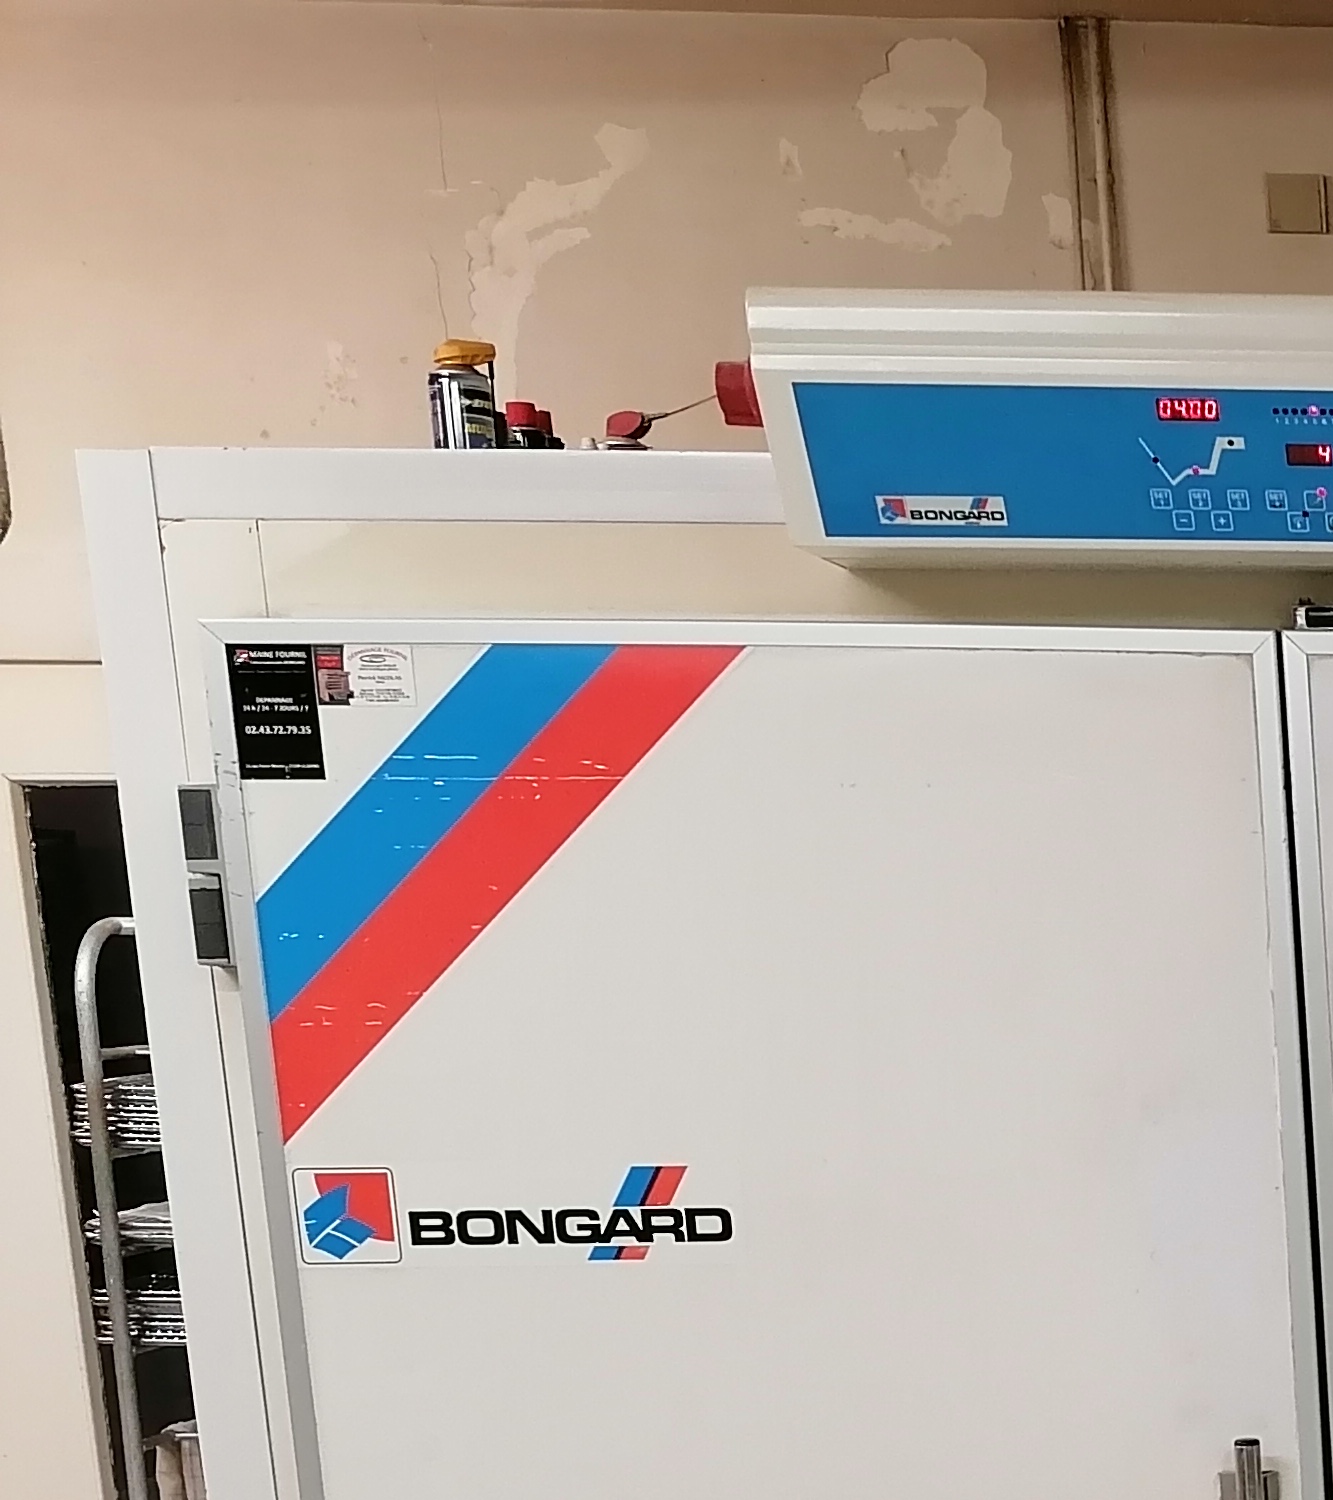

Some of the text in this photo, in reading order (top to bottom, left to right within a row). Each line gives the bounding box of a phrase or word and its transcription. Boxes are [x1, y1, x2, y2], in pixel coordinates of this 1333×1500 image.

[1159, 399, 1217, 419] 0400
[1318, 445, 1331, 463] 4
[909, 509, 1005, 521] BONGARD
[408, 1207, 733, 1246] BONGARD
